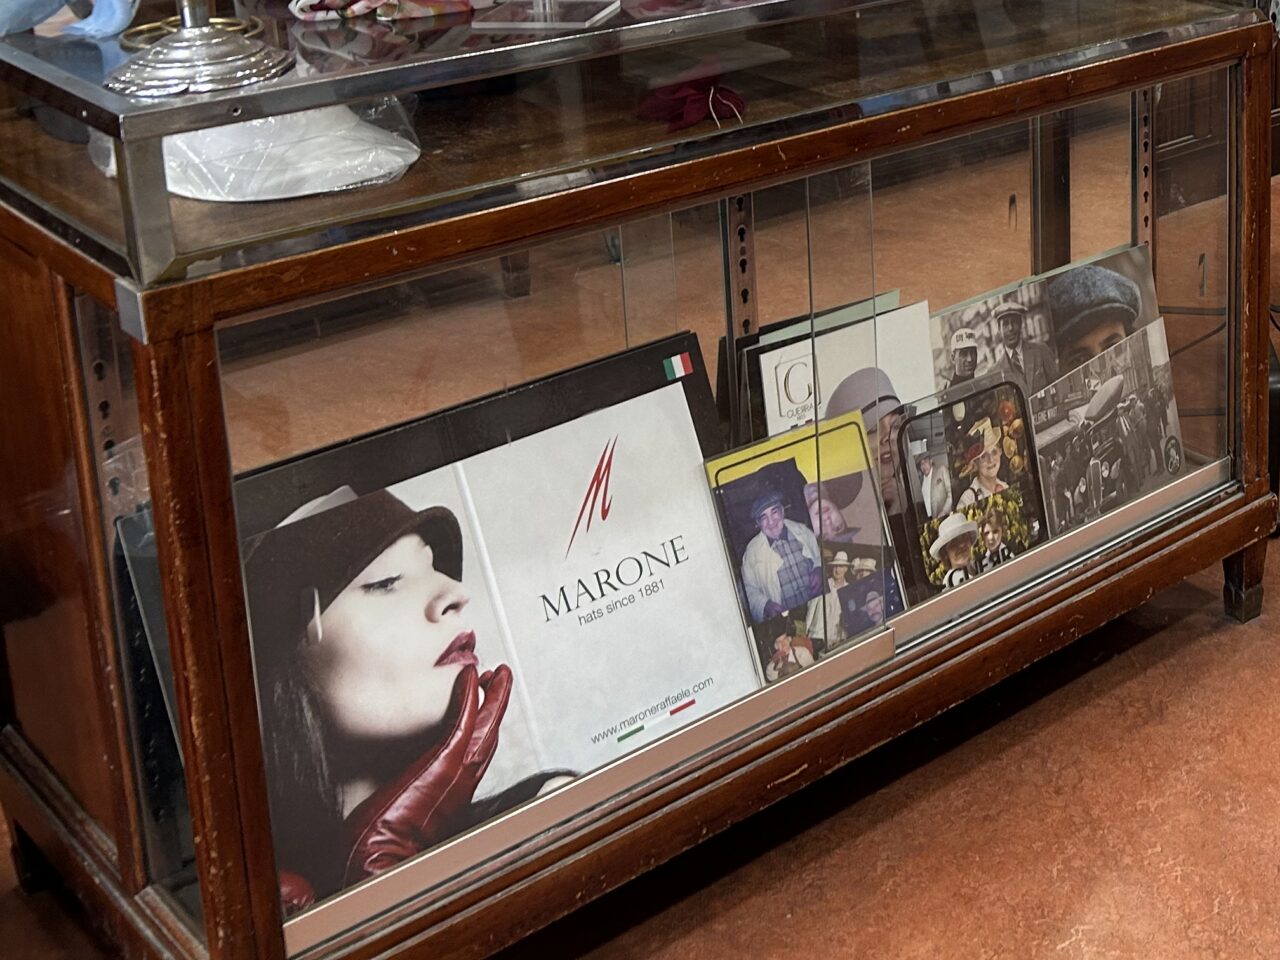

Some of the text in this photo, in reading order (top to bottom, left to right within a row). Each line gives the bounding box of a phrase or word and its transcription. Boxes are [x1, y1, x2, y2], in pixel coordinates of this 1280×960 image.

[539, 535, 690, 622] MARONE
[577, 578, 665, 626] hats since 1881
[590, 677, 714, 744] www.maroneraffaele.com
